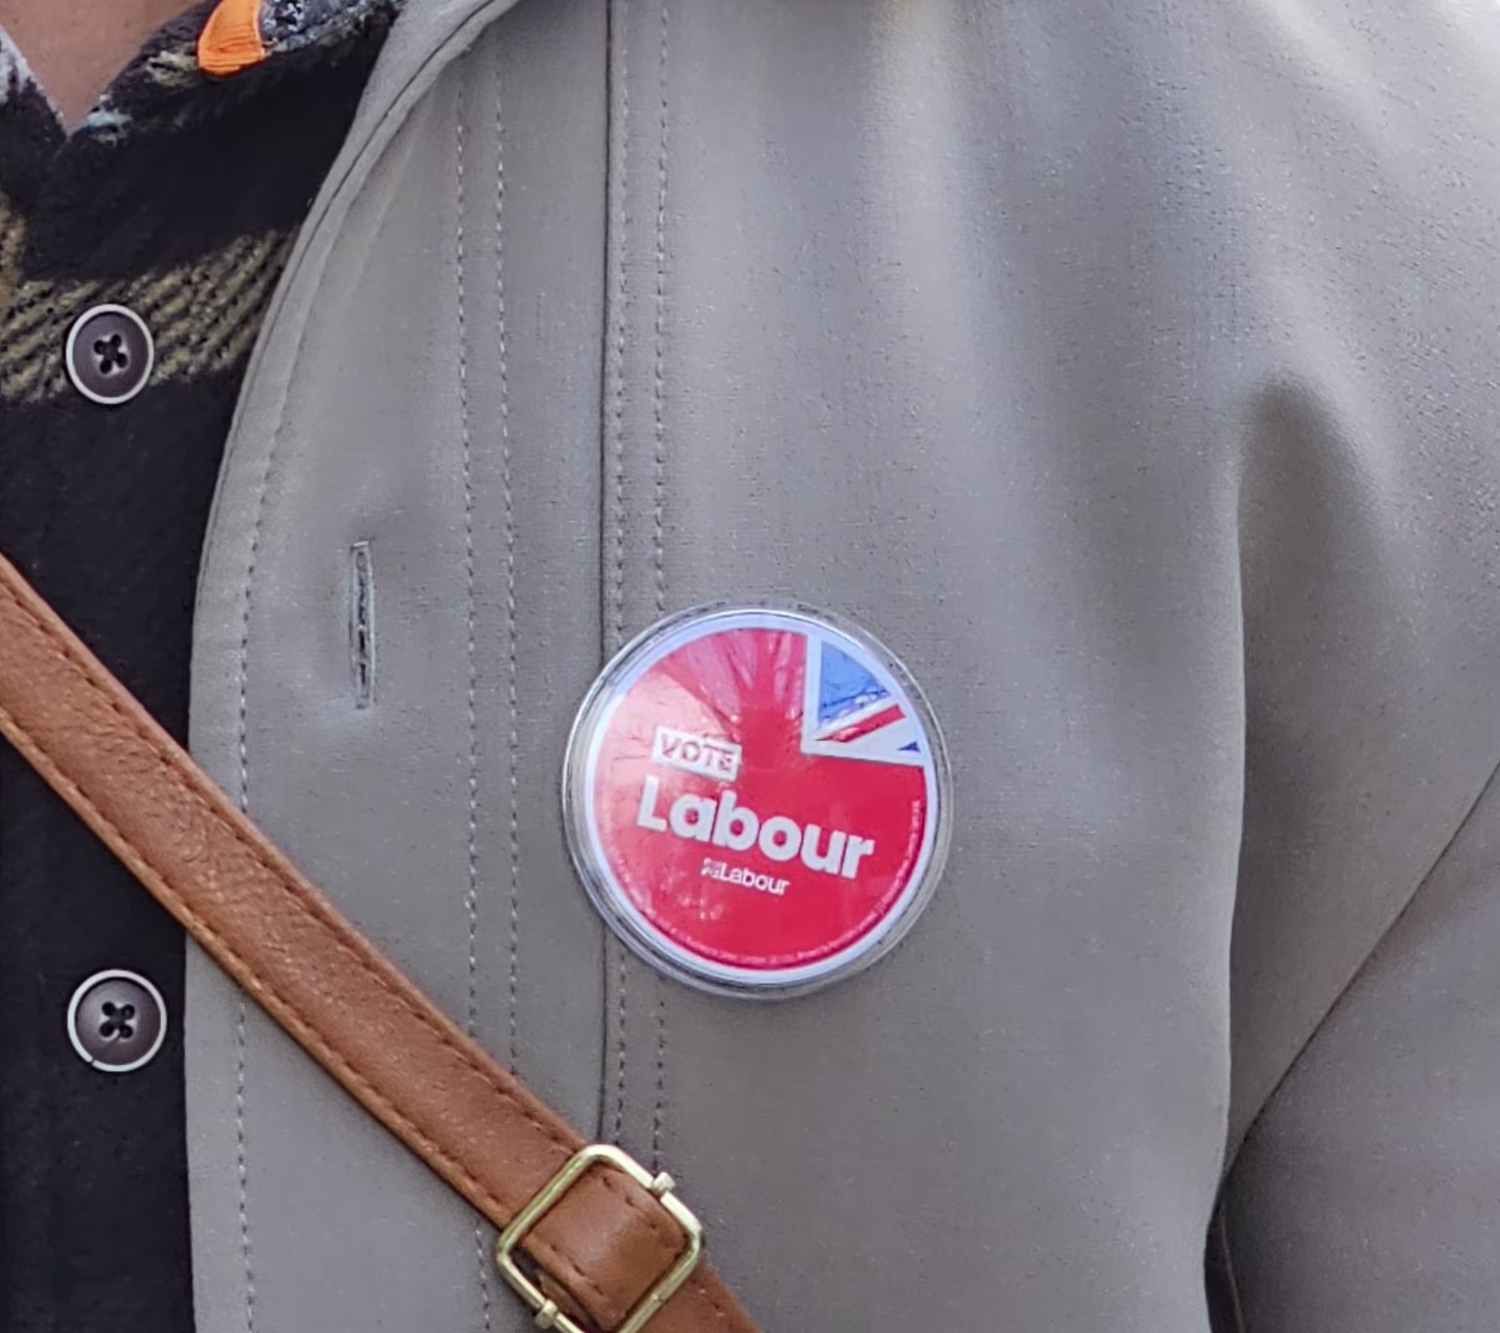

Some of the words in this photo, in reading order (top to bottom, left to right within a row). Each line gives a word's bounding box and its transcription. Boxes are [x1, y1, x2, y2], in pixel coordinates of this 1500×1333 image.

[661, 733, 734, 772] VOTE
[636, 775, 876, 879] Labour
[720, 862, 791, 896] Labour
